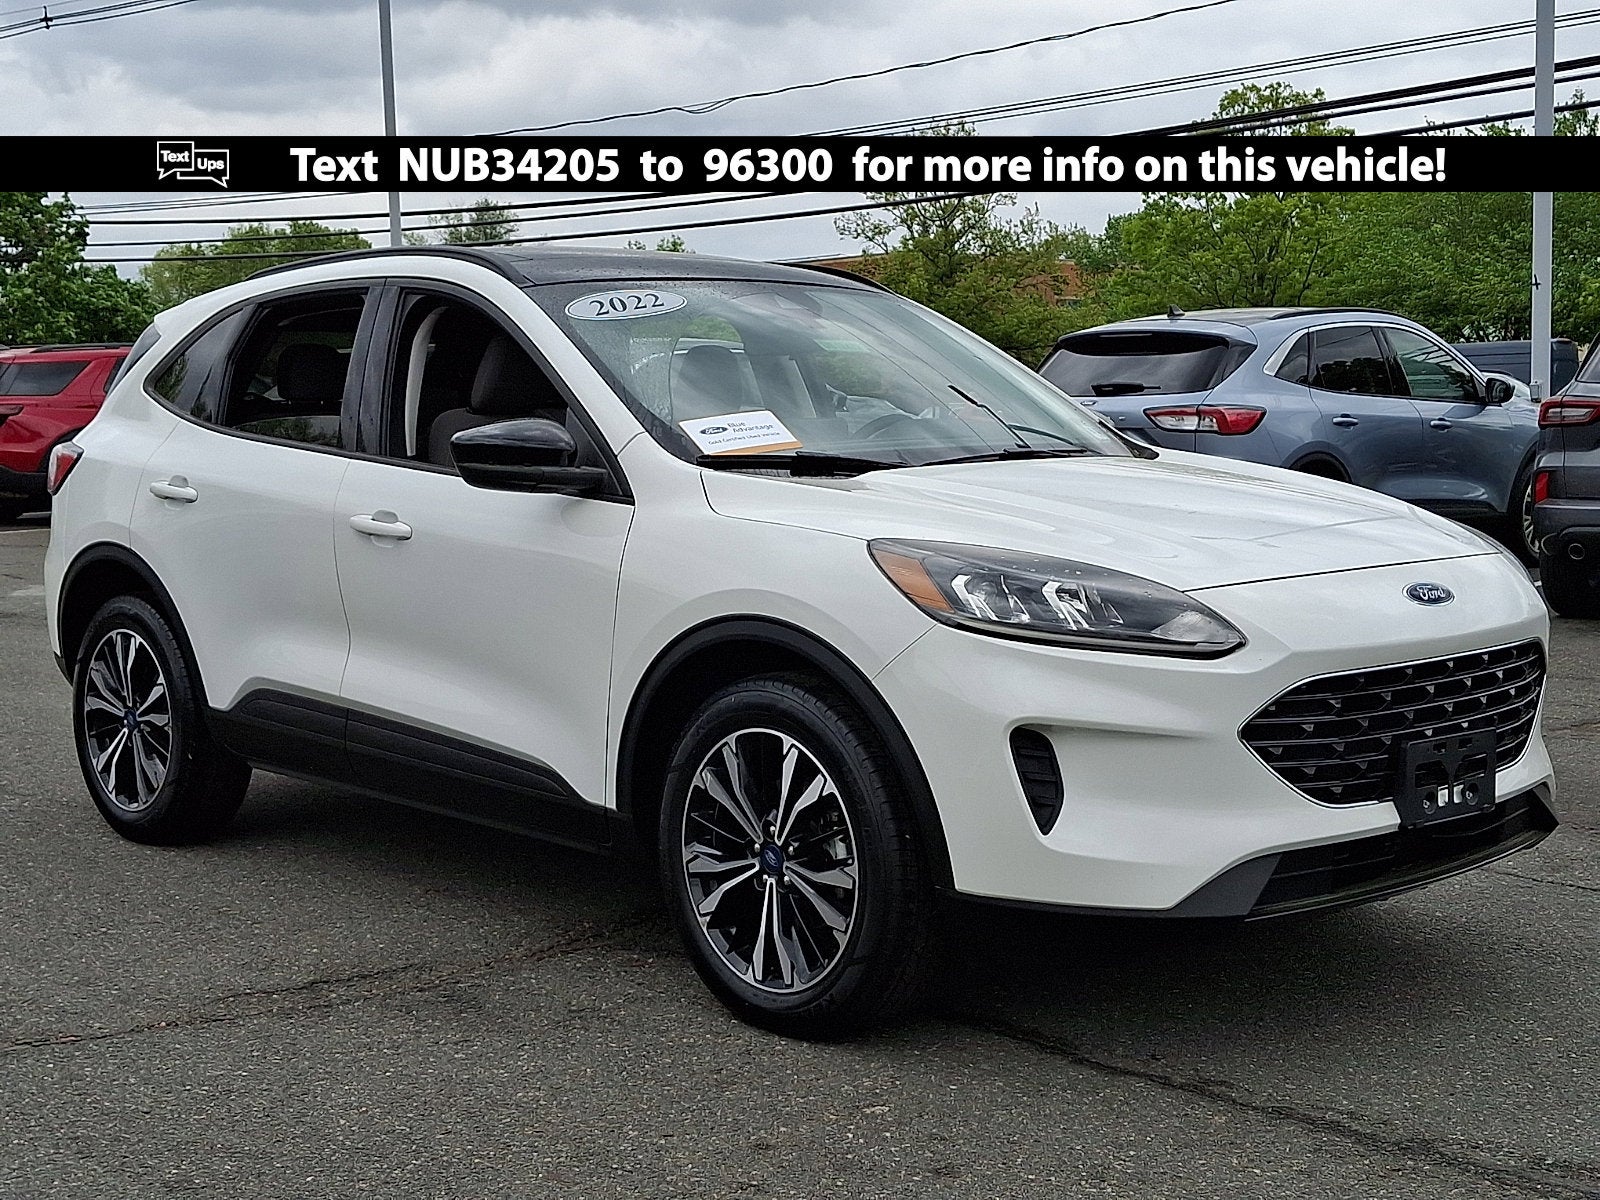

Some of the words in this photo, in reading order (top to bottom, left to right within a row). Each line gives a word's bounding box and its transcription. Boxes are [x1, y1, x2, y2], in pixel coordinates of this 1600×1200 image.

[589, 293, 665, 316] 2022
[732, 424, 774, 433] Advantage
[1416, 585, 1446, 600] Ford
